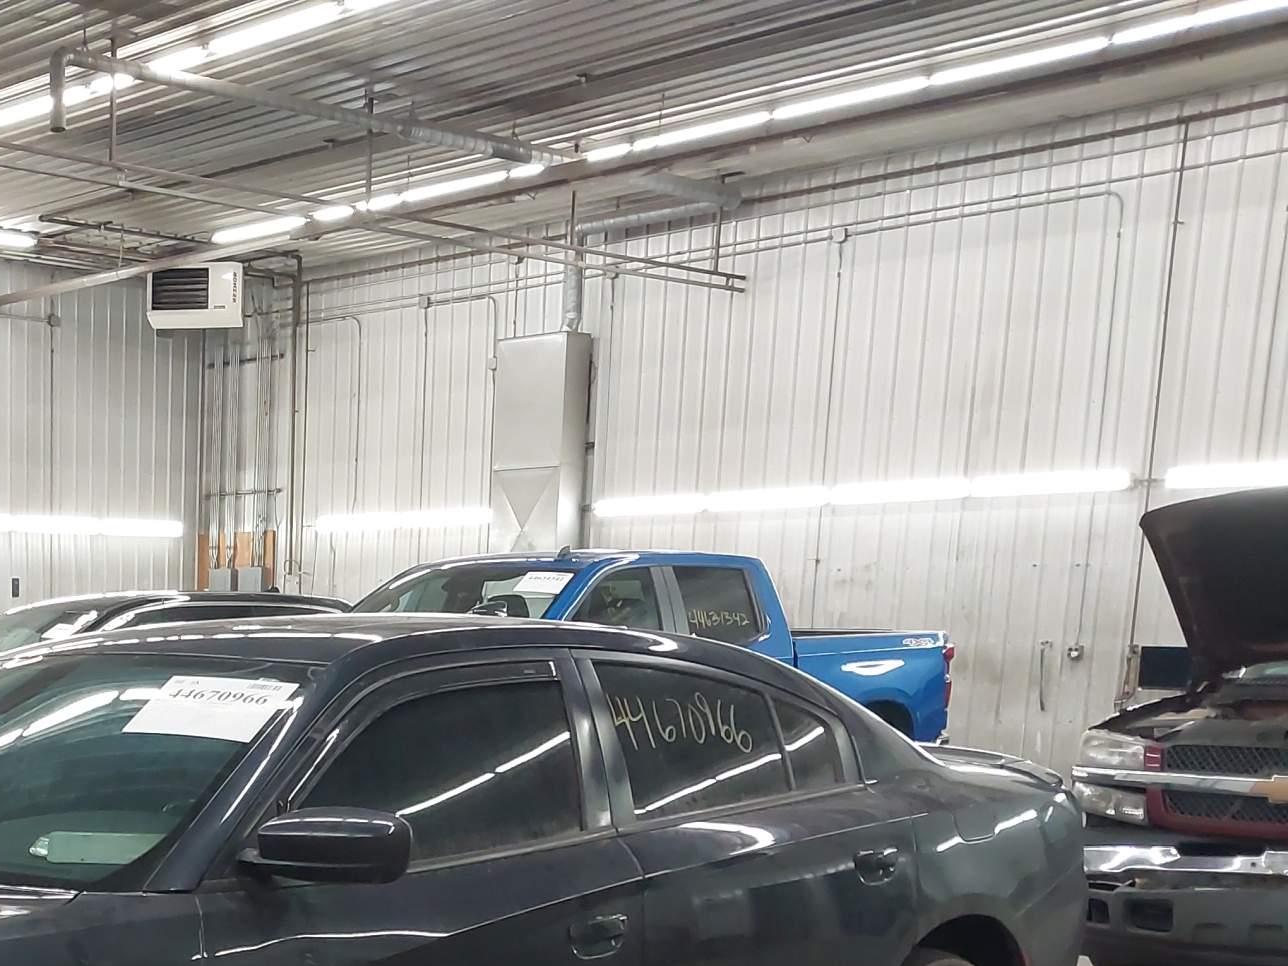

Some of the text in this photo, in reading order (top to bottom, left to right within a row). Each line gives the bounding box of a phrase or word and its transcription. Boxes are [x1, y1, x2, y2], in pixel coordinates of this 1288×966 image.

[688, 608, 751, 629] 44631342
[168, 687, 272, 706] 44670966
[606, 692, 753, 753] 44670966
